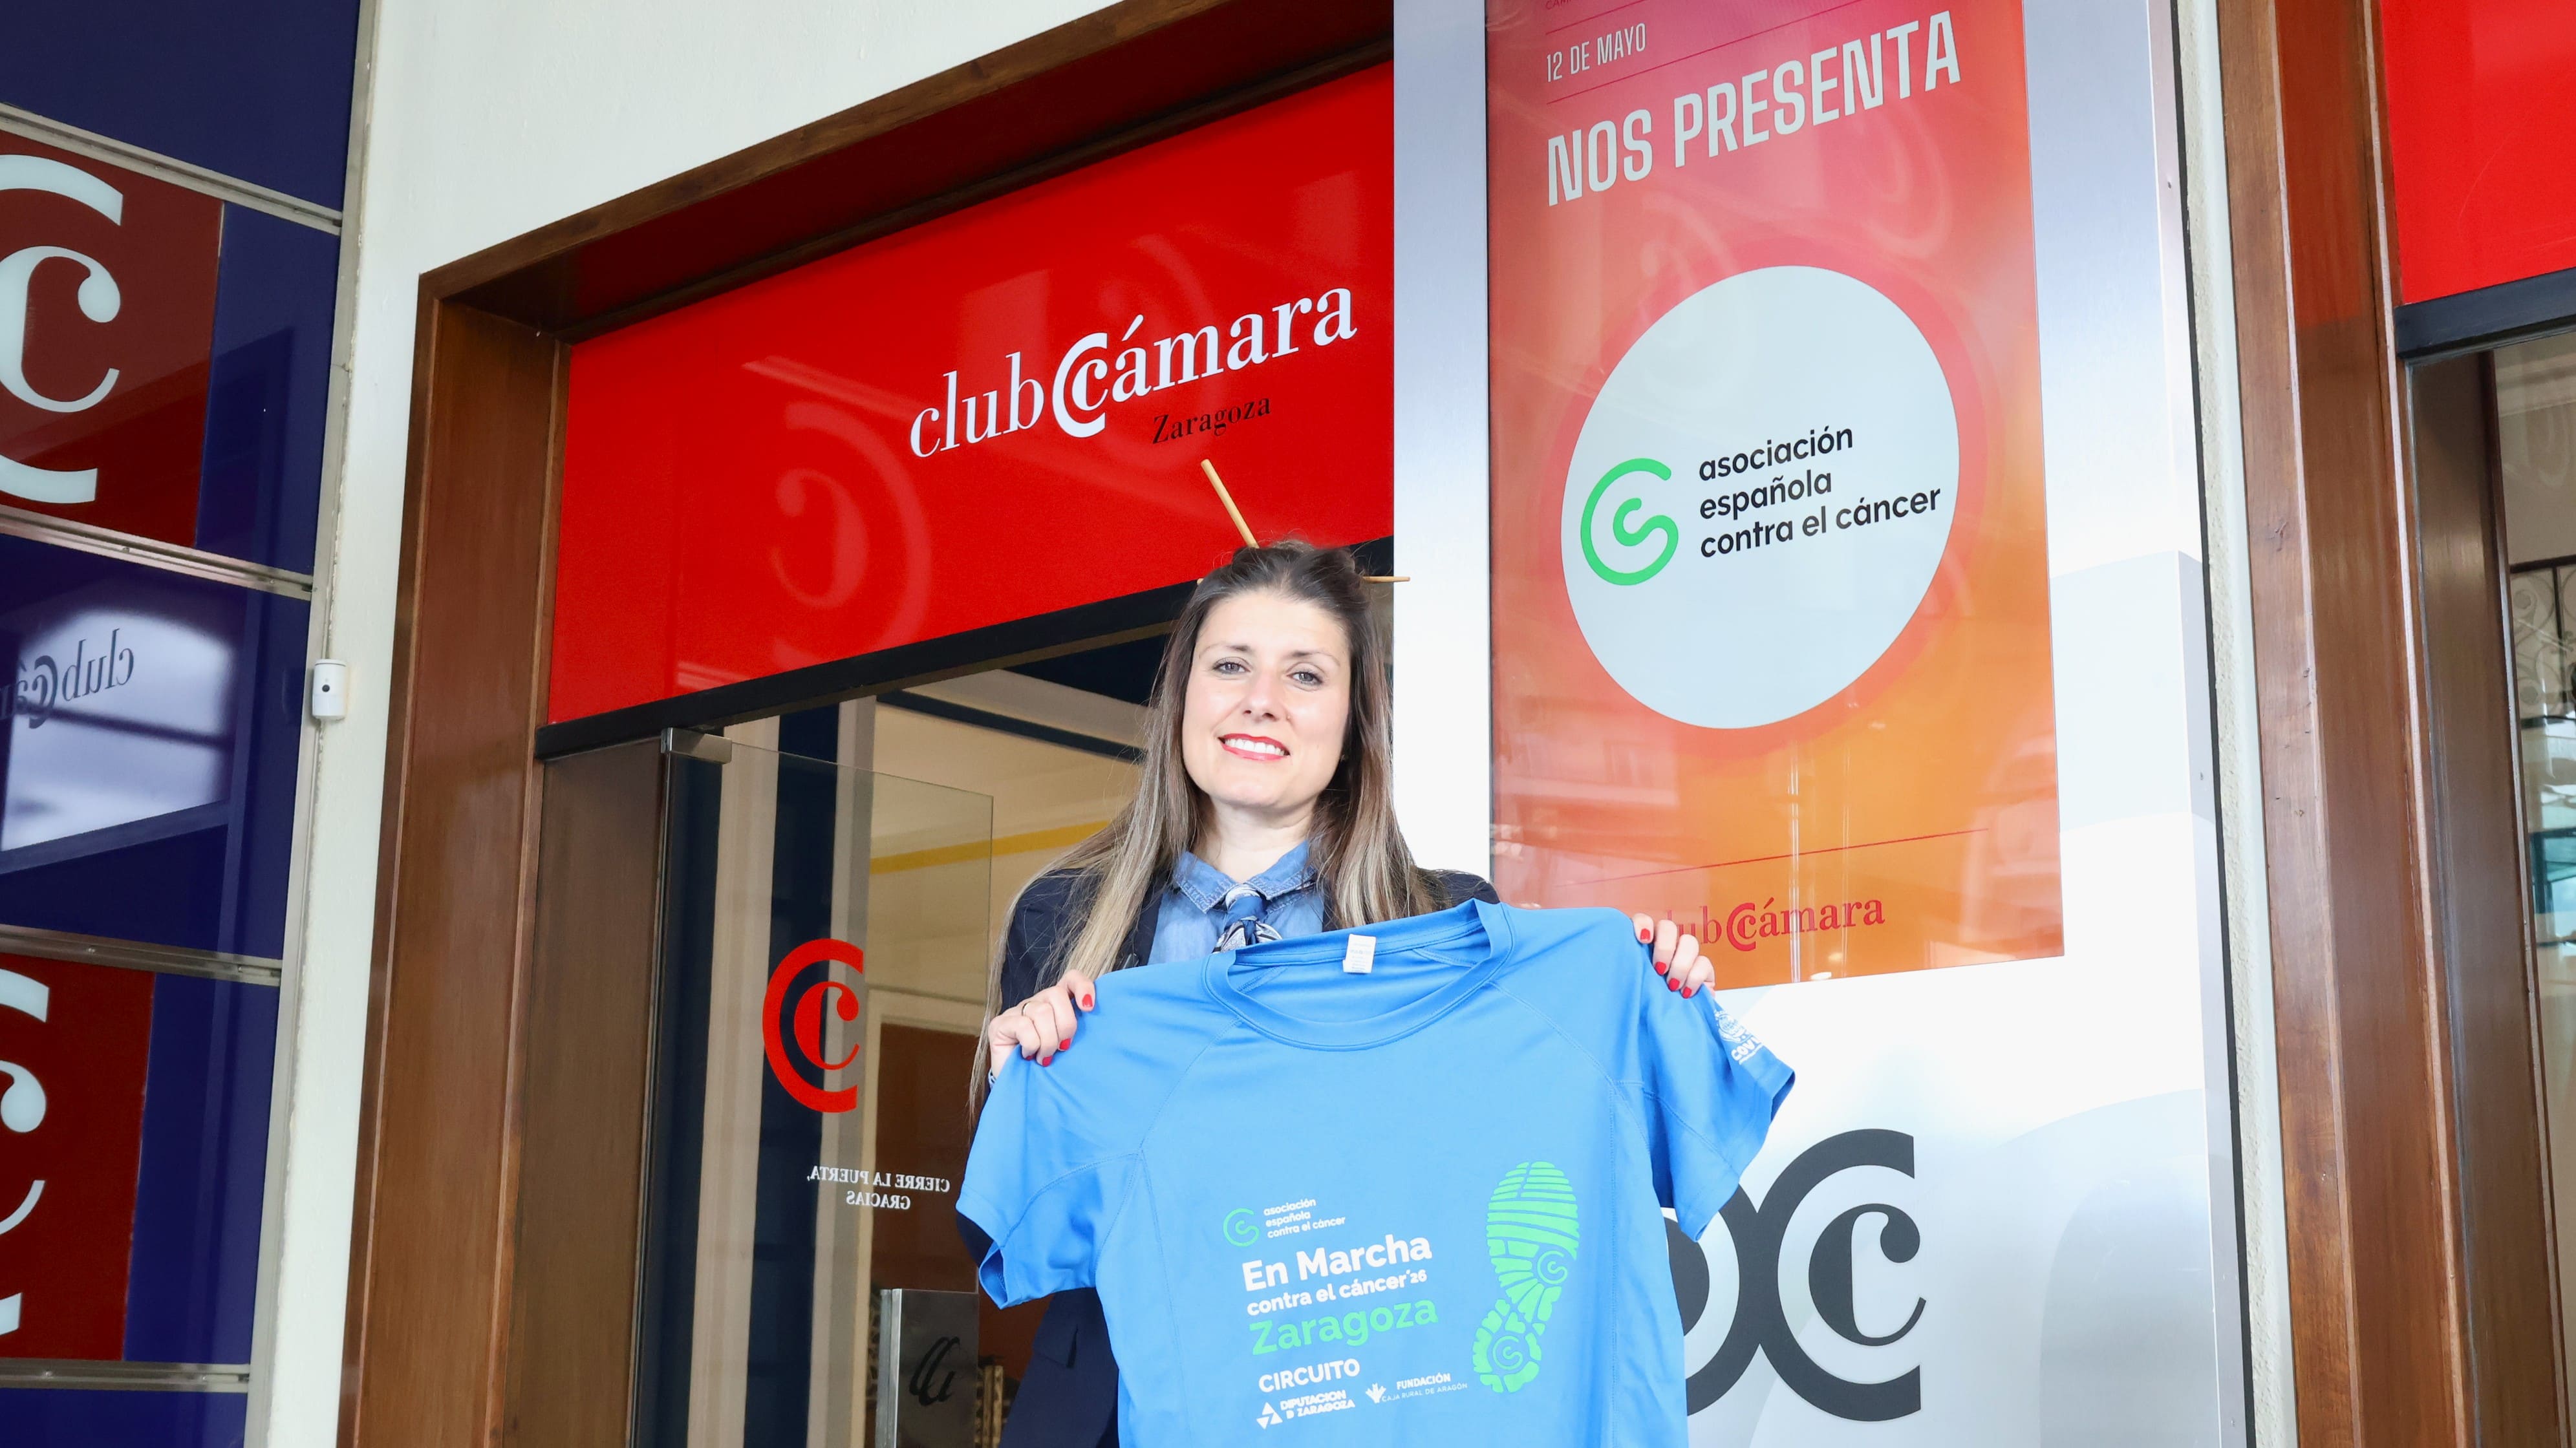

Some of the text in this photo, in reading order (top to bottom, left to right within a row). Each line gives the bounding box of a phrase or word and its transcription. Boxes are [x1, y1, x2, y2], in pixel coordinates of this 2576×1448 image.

[1547, 23, 1647, 82] 12 DE MAYO
[1548, 10, 1960, 206] NOS PRESENTA
[1152, 398, 1272, 445] Zaragoza
[1699, 426, 1853, 481] asociación
[1700, 469, 1832, 520] española
[1701, 489, 1941, 557] contra el cáncer
[1263, 1198, 1316, 1216] asociación
[1265, 1211, 1311, 1227] española
[1267, 1217, 1346, 1239] contra el cáncer
[1242, 1234, 1432, 1292] En Marcha
[1247, 1292, 1312, 1316] contra
[1316, 1283, 1336, 1303] el
[1249, 1299, 1439, 1356] Zaragoza
[1258, 1358, 1360, 1392] CIRCUITO
[1397, 1372, 1451, 1390] FUNDACIÓN
[1402, 1390, 1423, 1399] RURAL
[1437, 1383, 1468, 1393] ARAGÓN
[1297, 1400, 1356, 1417] ZARAGOZA
